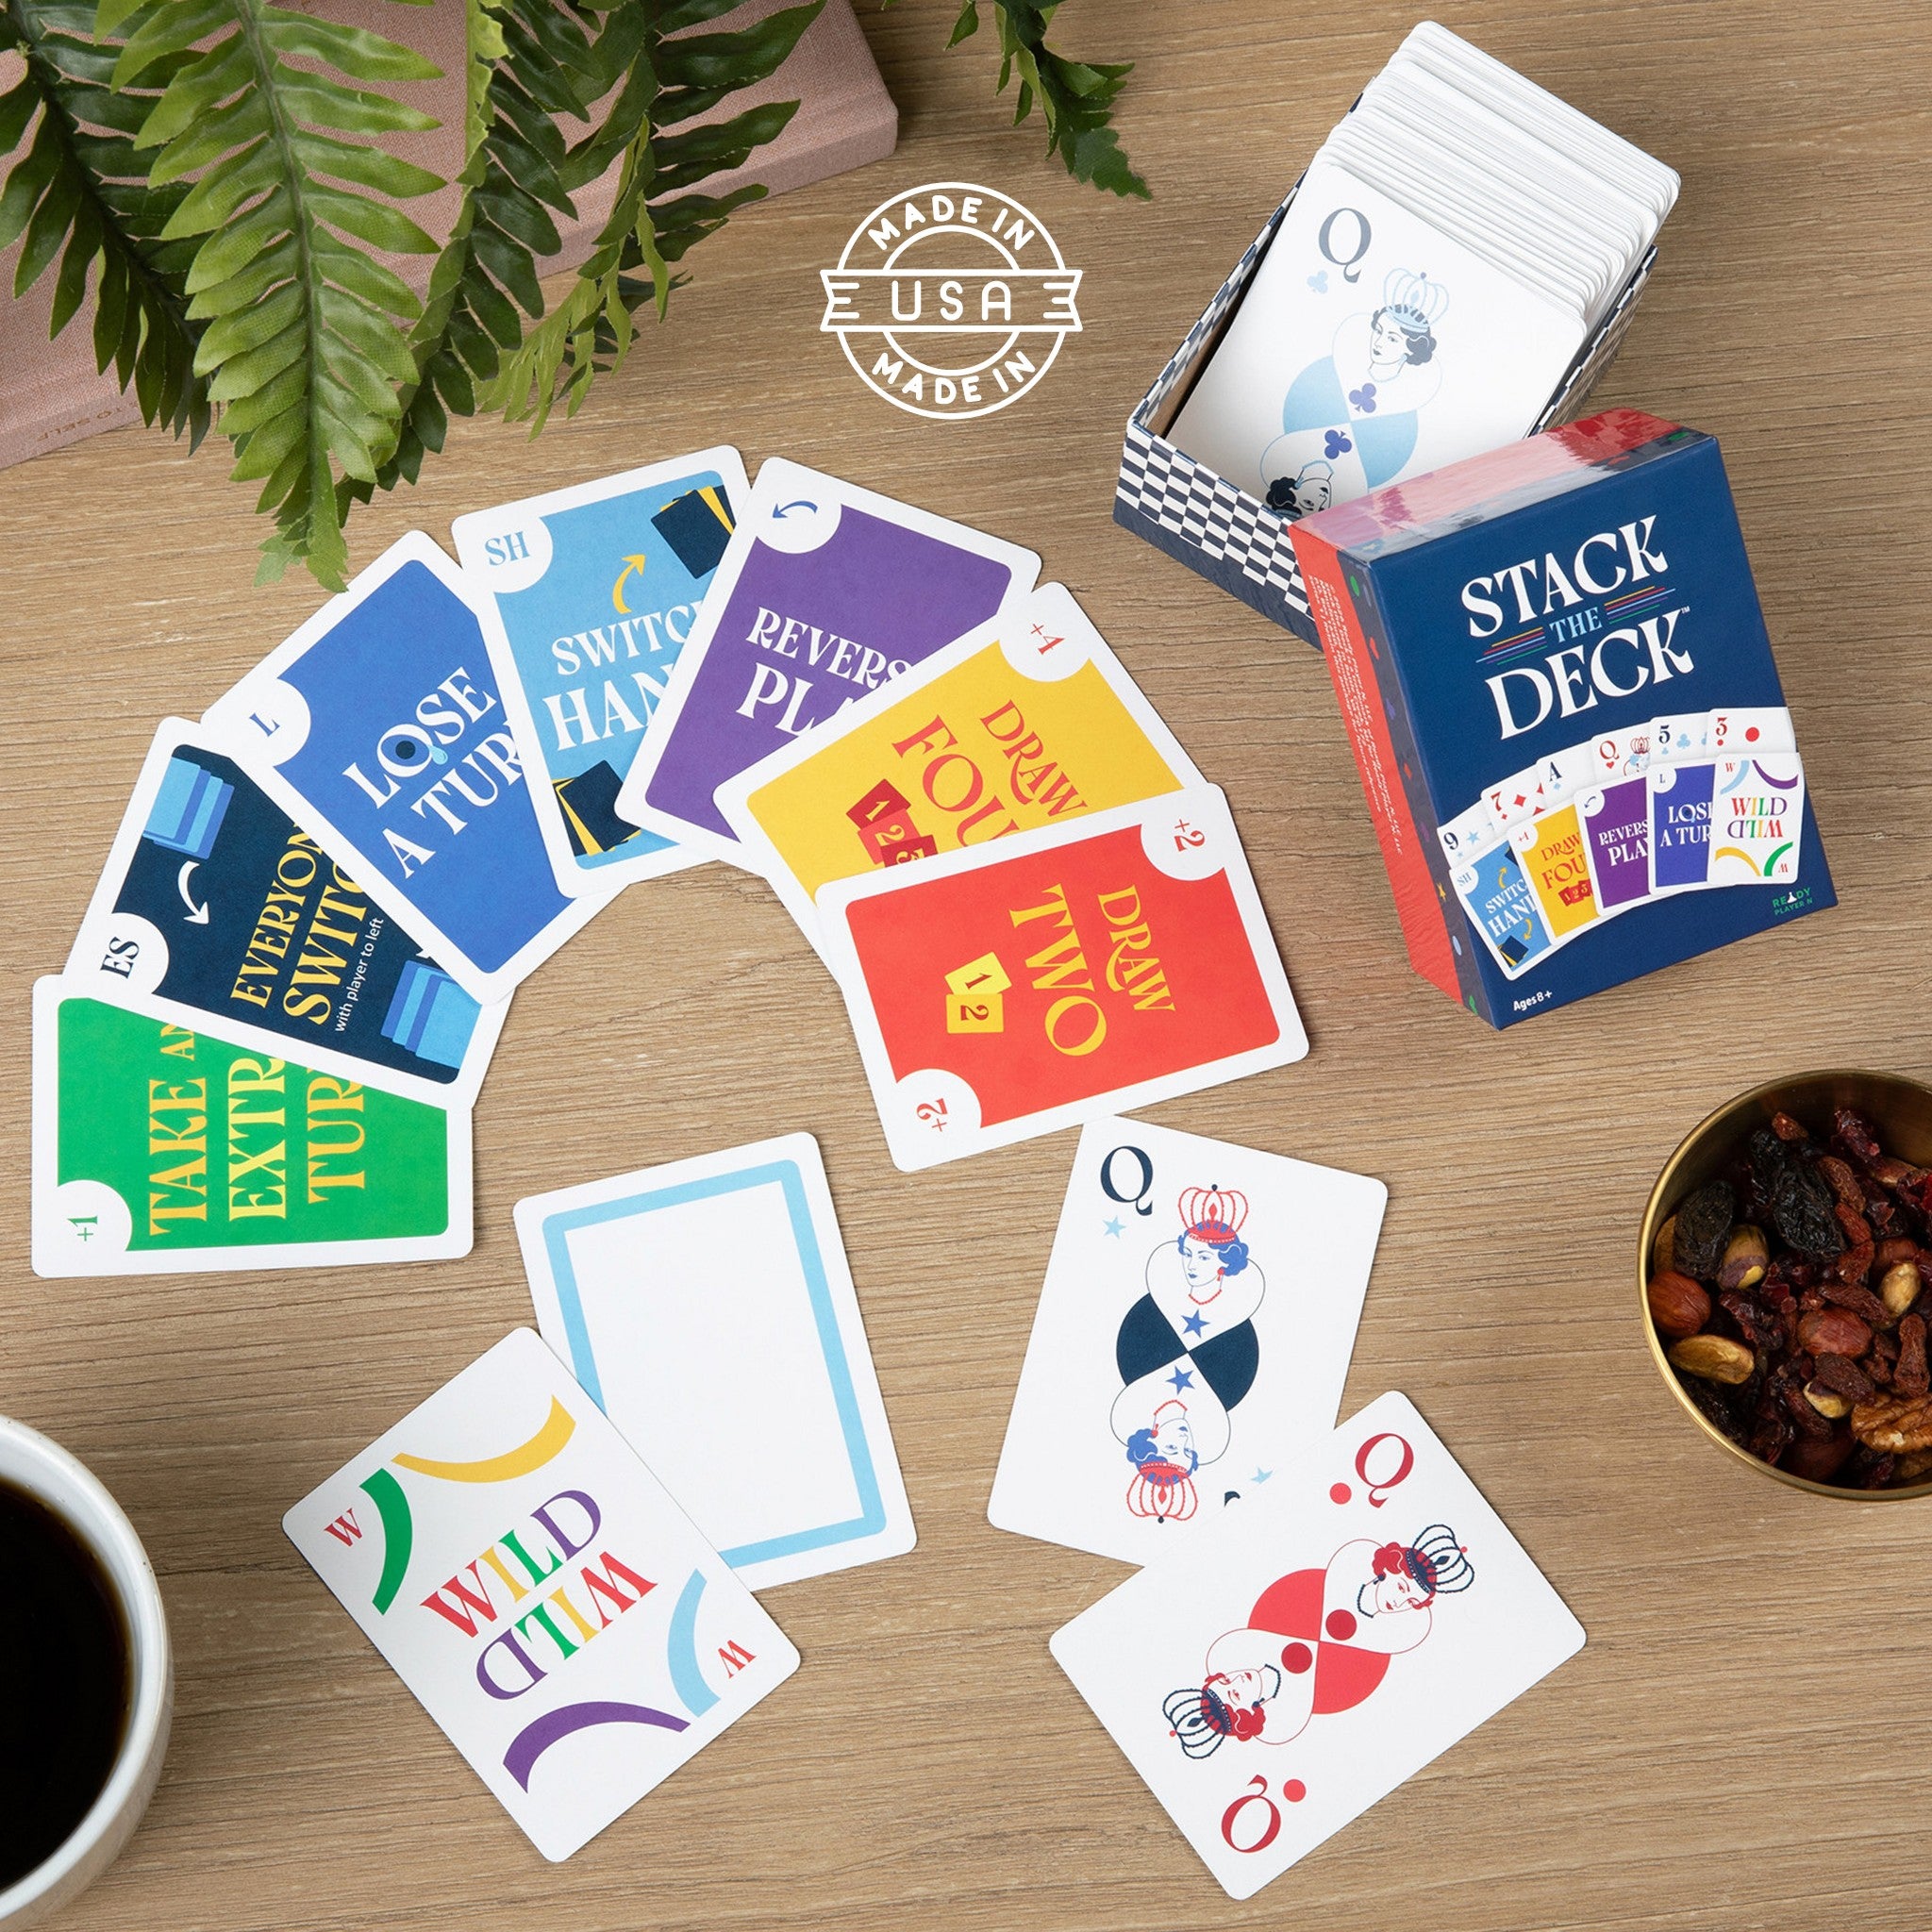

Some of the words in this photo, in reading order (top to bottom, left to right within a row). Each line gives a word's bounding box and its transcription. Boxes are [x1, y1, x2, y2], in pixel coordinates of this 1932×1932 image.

[1319, 208, 1372, 283] Q
[484, 531, 530, 566] SH
[1461, 514, 1669, 638] STACK
[552, 599, 702, 675] SWITC
[1030, 623, 1066, 655] +4
[1549, 607, 1603, 643] THE
[736, 661, 854, 738] PL
[249, 712, 280, 737] L
[341, 666, 497, 809] LOSE
[1658, 724, 1671, 744] 5
[1715, 717, 1728, 737] 3
[979, 699, 1089, 817] DRAW
[1599, 740, 1620, 760] Q
[1548, 761, 1562, 782] A
[382, 827, 436, 878] A
[410, 719, 524, 835] TUR
[865, 800, 890, 822] 1
[1491, 791, 1502, 812] 7
[1731, 796, 1788, 816] WILD
[874, 824, 906, 845] 2
[1174, 819, 1206, 852] +2
[1443, 832, 1458, 850] 9
[1541, 832, 1581, 860] DRAW
[1660, 829, 1673, 847] A
[1726, 819, 1783, 839] WILD
[365, 917, 384, 940] left
[100, 936, 140, 979] ES
[360, 942, 375, 958] to
[1097, 884, 1175, 1011] DRAW
[346, 959, 368, 1001] player
[965, 973, 992, 991] 1
[1008, 883, 1107, 1057] TWO
[335, 1002, 353, 1032] with
[959, 1004, 990, 1022] 2
[916, 1098, 948, 1132] +2
[228, 1058, 286, 1222] EXTR
[307, 1068, 366, 1205] TUR
[149, 1077, 208, 1236] TAKE
[1100, 1145, 1154, 1216] Q
[67, 1215, 98, 1242] +1
[1355, 1433, 1414, 1508] Q
[324, 1508, 363, 1547] W
[420, 1490, 602, 1638] WILD
[476, 1551, 658, 1700] WILD
[717, 1640, 758, 1678] W
[1221, 1774, 1282, 1853] Q
